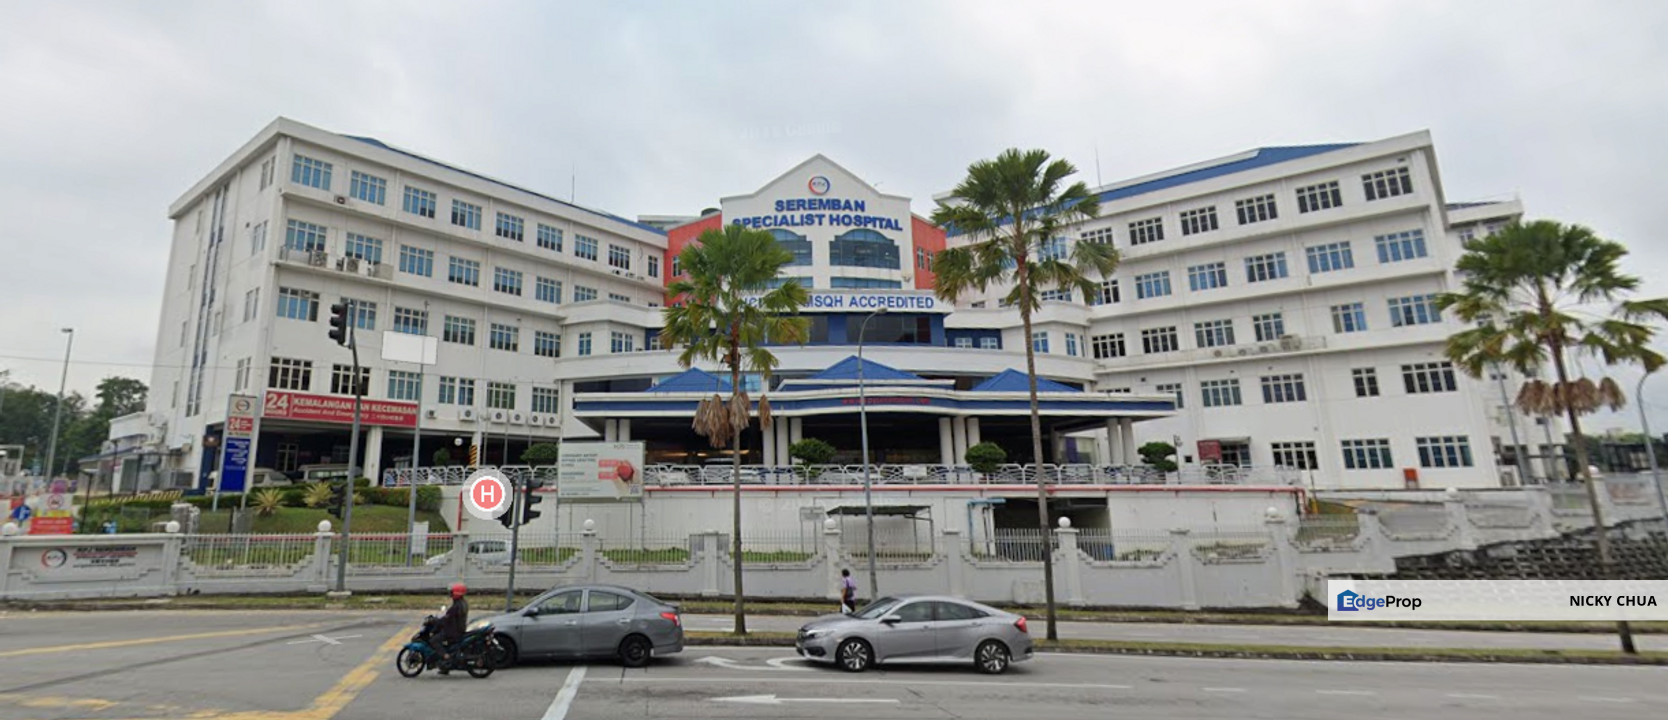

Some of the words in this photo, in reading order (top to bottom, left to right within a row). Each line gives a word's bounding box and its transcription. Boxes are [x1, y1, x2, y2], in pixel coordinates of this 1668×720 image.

[774, 198, 866, 212] SEREMBAN
[732, 213, 826, 229] SPECIALIST
[829, 213, 903, 231] HOSPITAL
[849, 295, 934, 309] ACCREDITED
[266, 393, 289, 409] 24
[293, 398, 352, 410] KEMALANGAN
[371, 404, 418, 414] KECEMASAN
[293, 407, 321, 415] Accident
[336, 411, 369, 419] Emergcy
[228, 417, 241, 430] 24
